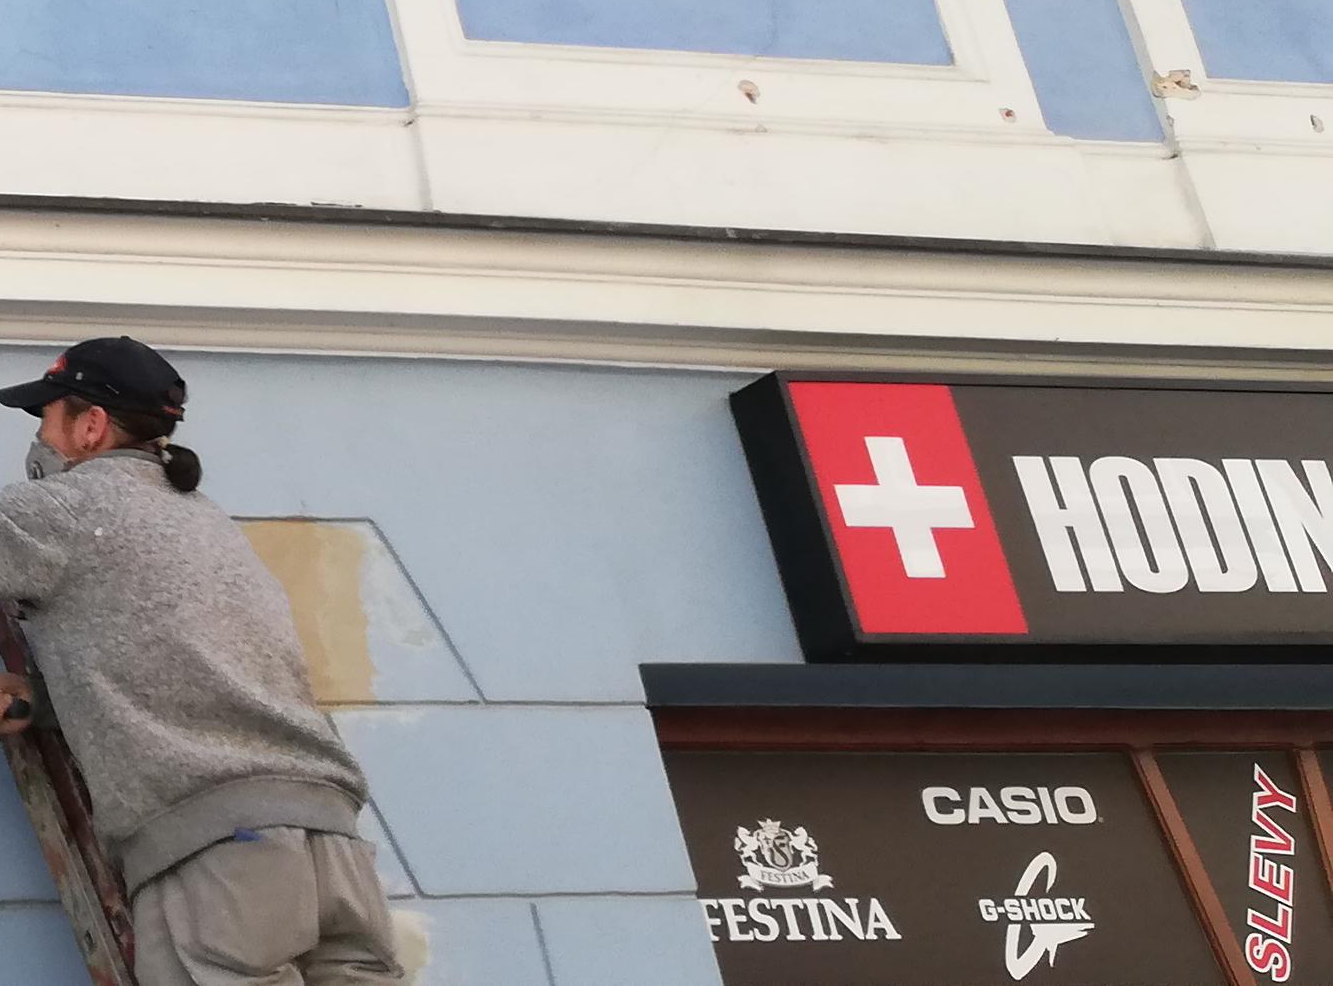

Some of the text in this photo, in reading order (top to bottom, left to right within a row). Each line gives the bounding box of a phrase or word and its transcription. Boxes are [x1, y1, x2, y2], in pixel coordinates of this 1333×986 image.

[1011, 456, 1333, 594] HODIN
[921, 786, 1097, 825] CASIO
[760, 870, 810, 884] FESTINA
[1244, 762, 1297, 983] SLEVY
[699, 897, 903, 942] FESTINA
[978, 897, 1092, 922] G-SHOCK
